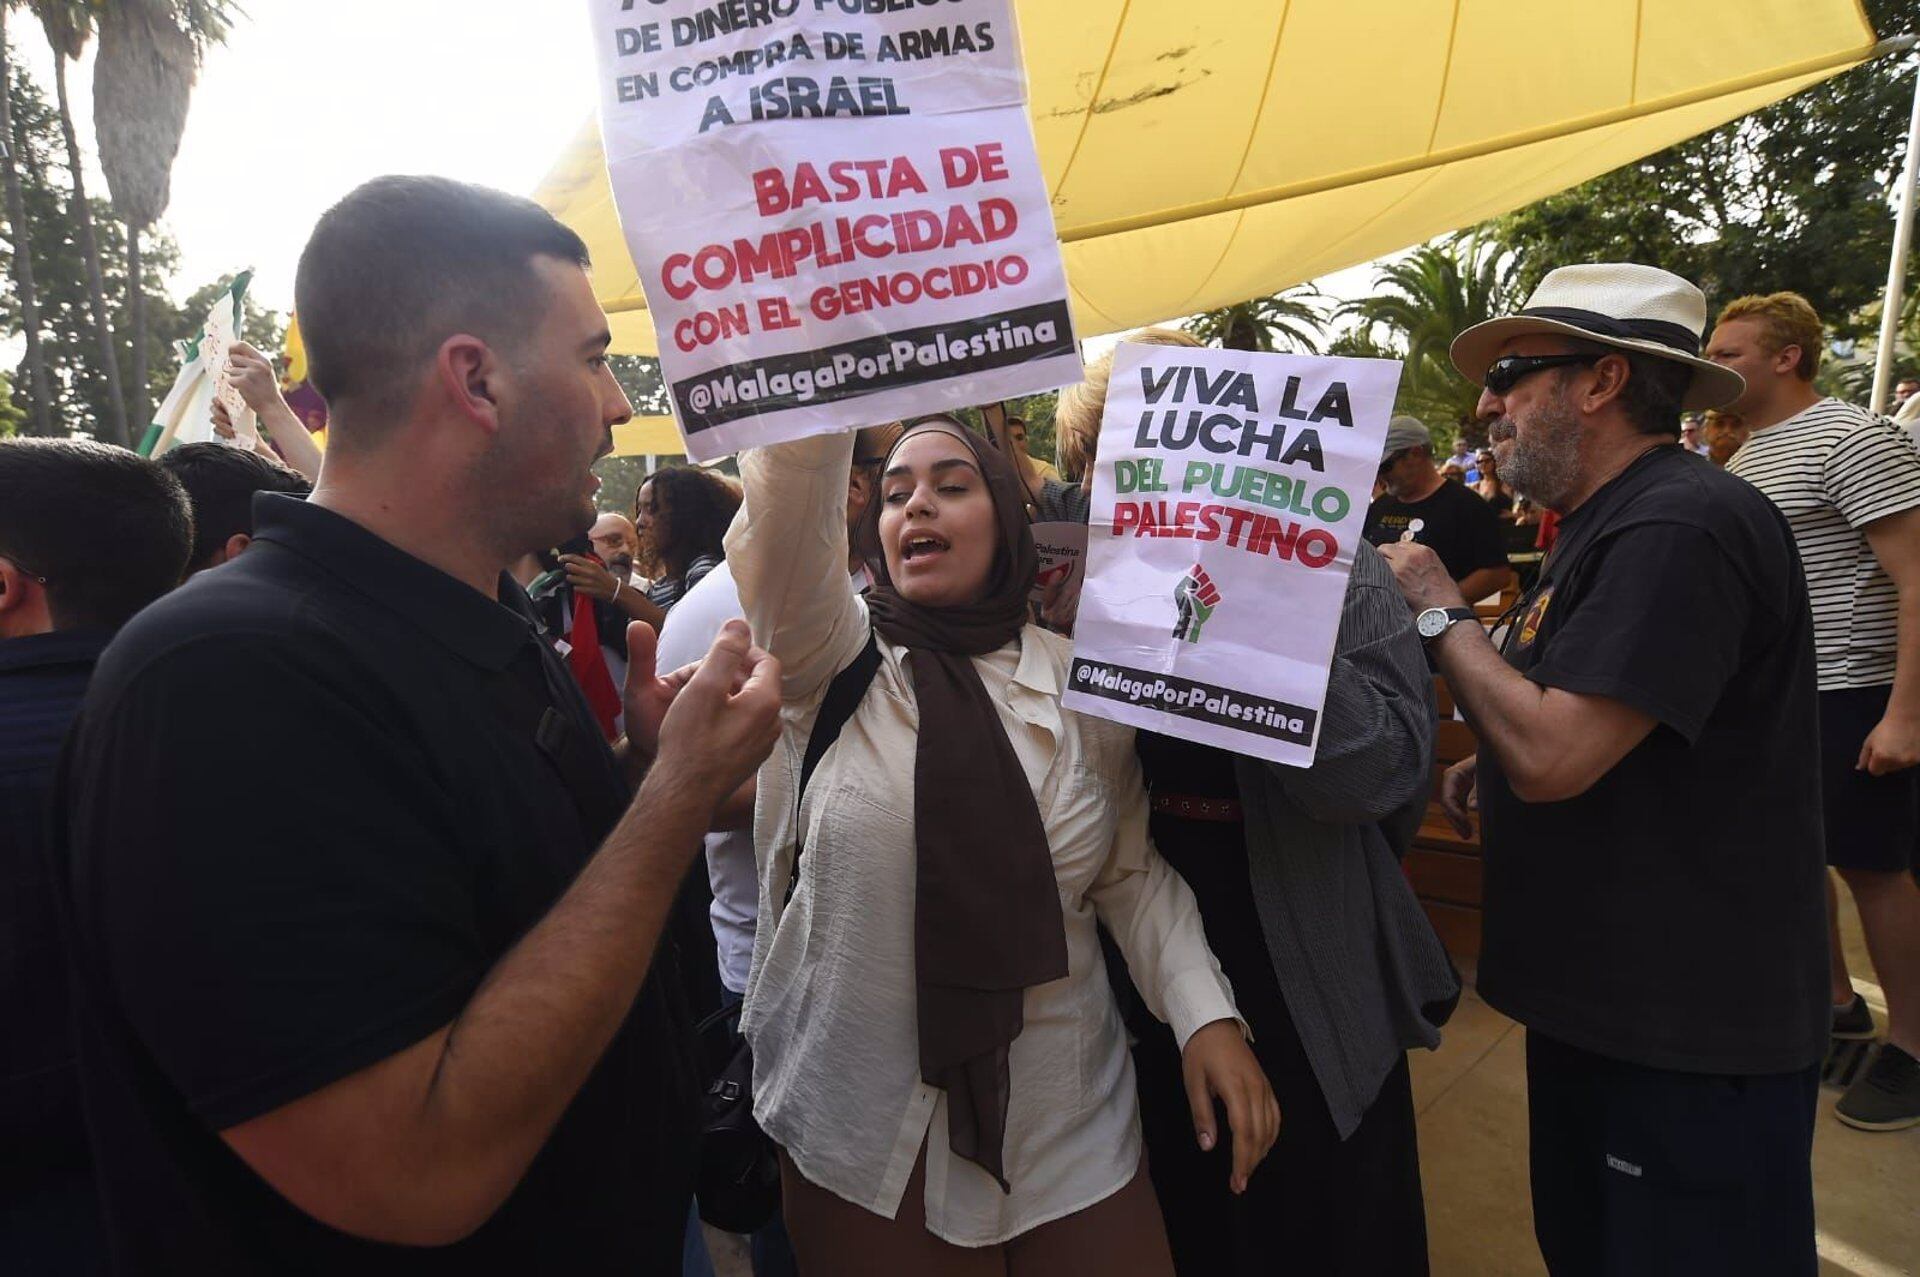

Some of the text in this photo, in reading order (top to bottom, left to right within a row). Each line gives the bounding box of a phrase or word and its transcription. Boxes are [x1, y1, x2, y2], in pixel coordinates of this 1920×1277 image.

[616, 0, 800, 57] DE DINERO
[617, 22, 995, 103] EN COMPRA DE ARMAS
[698, 76, 911, 134] A ISRAEL
[753, 142, 1009, 217] BASTA DE
[661, 197, 1019, 300] COMPLICIDAD
[674, 255, 1029, 353] CON EL GENOCIDIO
[688, 317, 1058, 414] @MalagaPorPalestina
[1140, 365, 1354, 428] VIVA LA
[1134, 410, 1325, 473] LUCHA
[1114, 457, 1351, 523] DEL PUEBLO
[1112, 502, 1340, 569] PALESTINO
[1076, 663, 1305, 735] @MalagaPorPalestina
